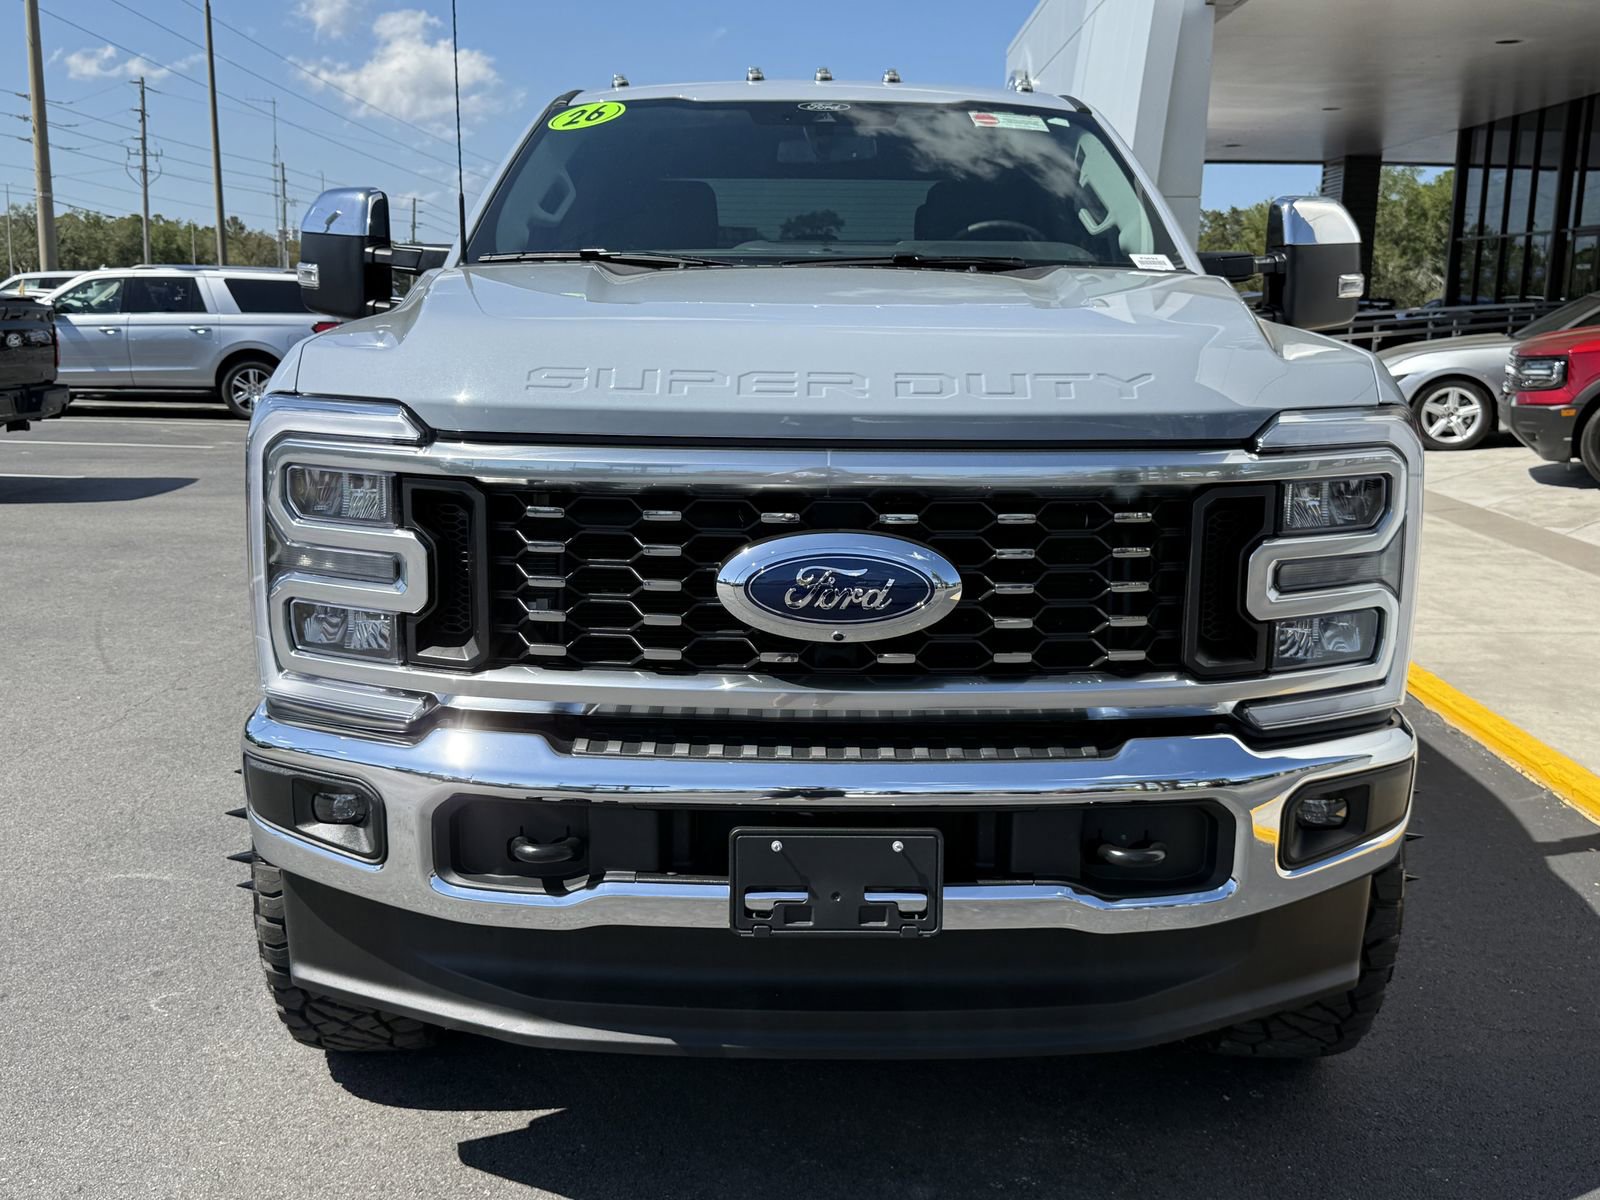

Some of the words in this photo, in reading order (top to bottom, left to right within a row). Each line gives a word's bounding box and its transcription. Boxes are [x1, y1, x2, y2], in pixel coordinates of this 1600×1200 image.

[561, 104, 608, 127] 26
[525, 366, 870, 399] SUPER
[894, 372, 1156, 400] DUTY
[783, 565, 896, 610] Ford
